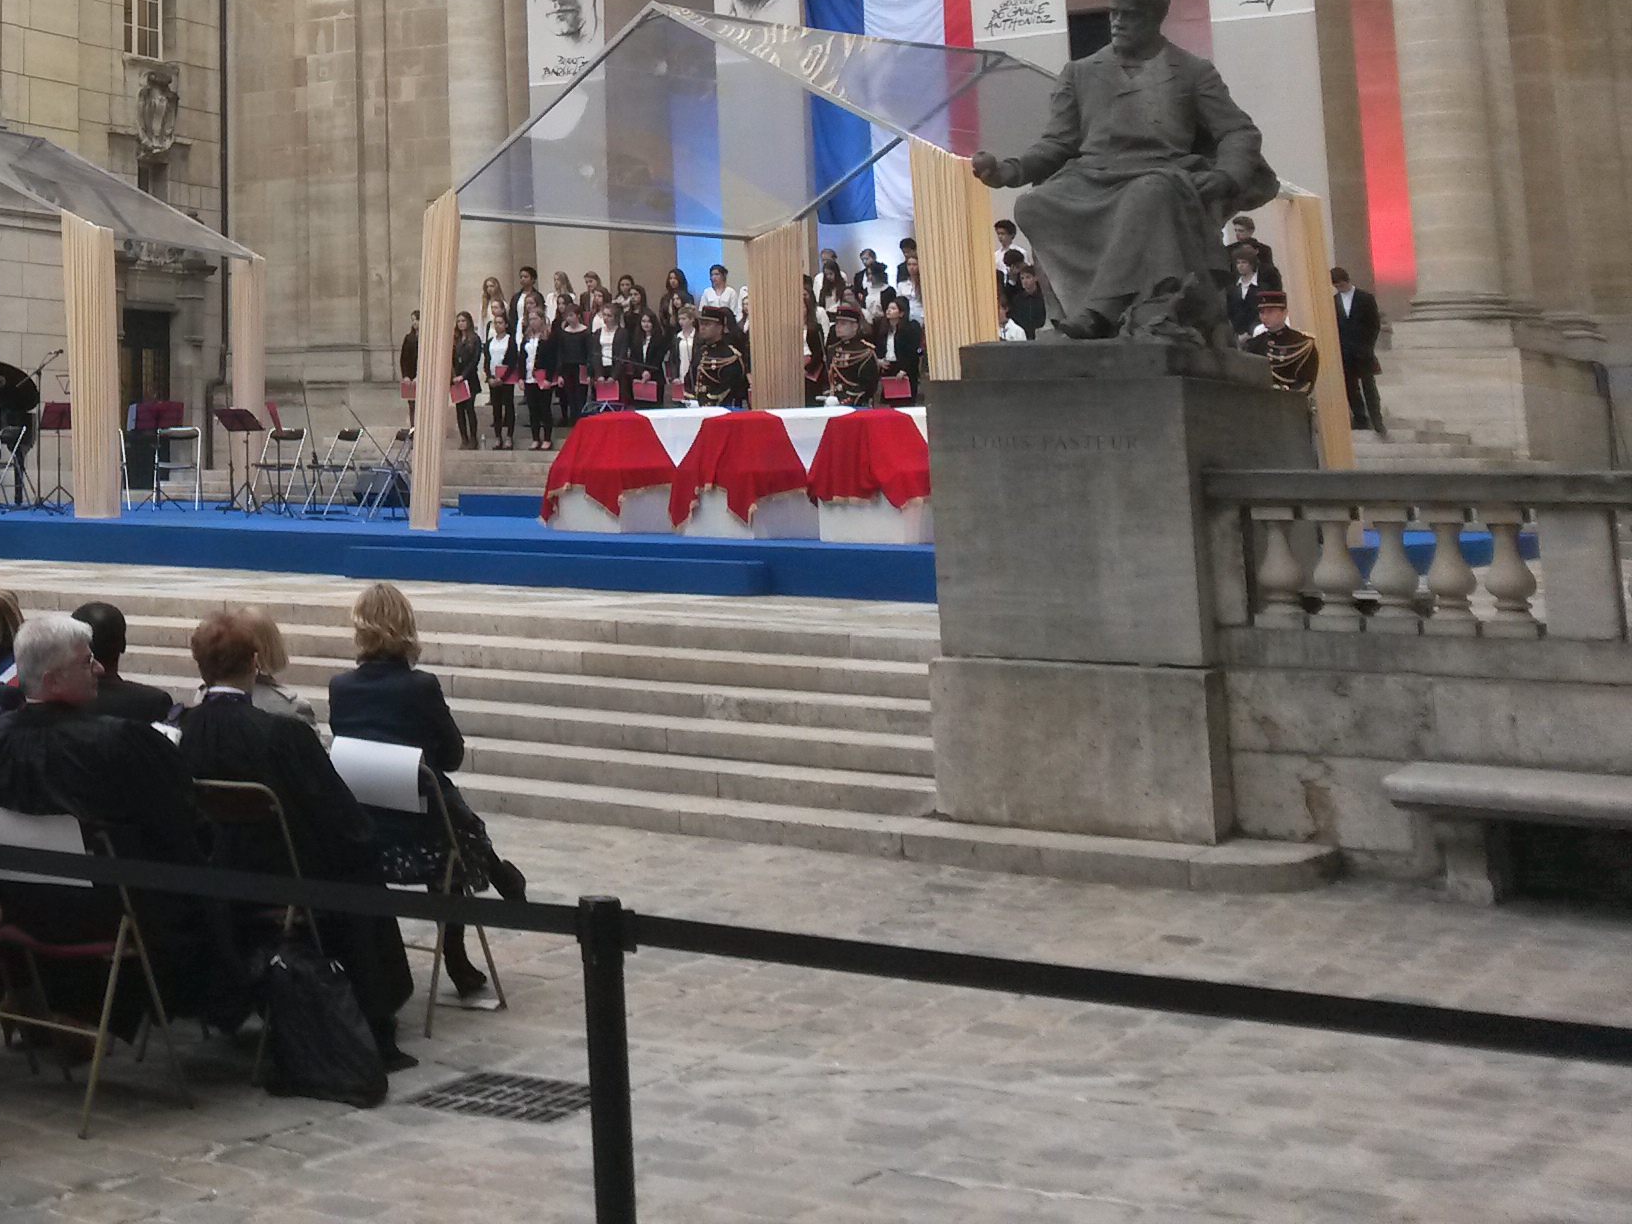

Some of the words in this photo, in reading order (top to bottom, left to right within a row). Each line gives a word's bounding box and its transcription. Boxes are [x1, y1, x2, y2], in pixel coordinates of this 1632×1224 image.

[991, 7, 1009, 21] DE
[971, 435, 1031, 451] LOUIS
[1041, 435, 1138, 452] PASTEUR
